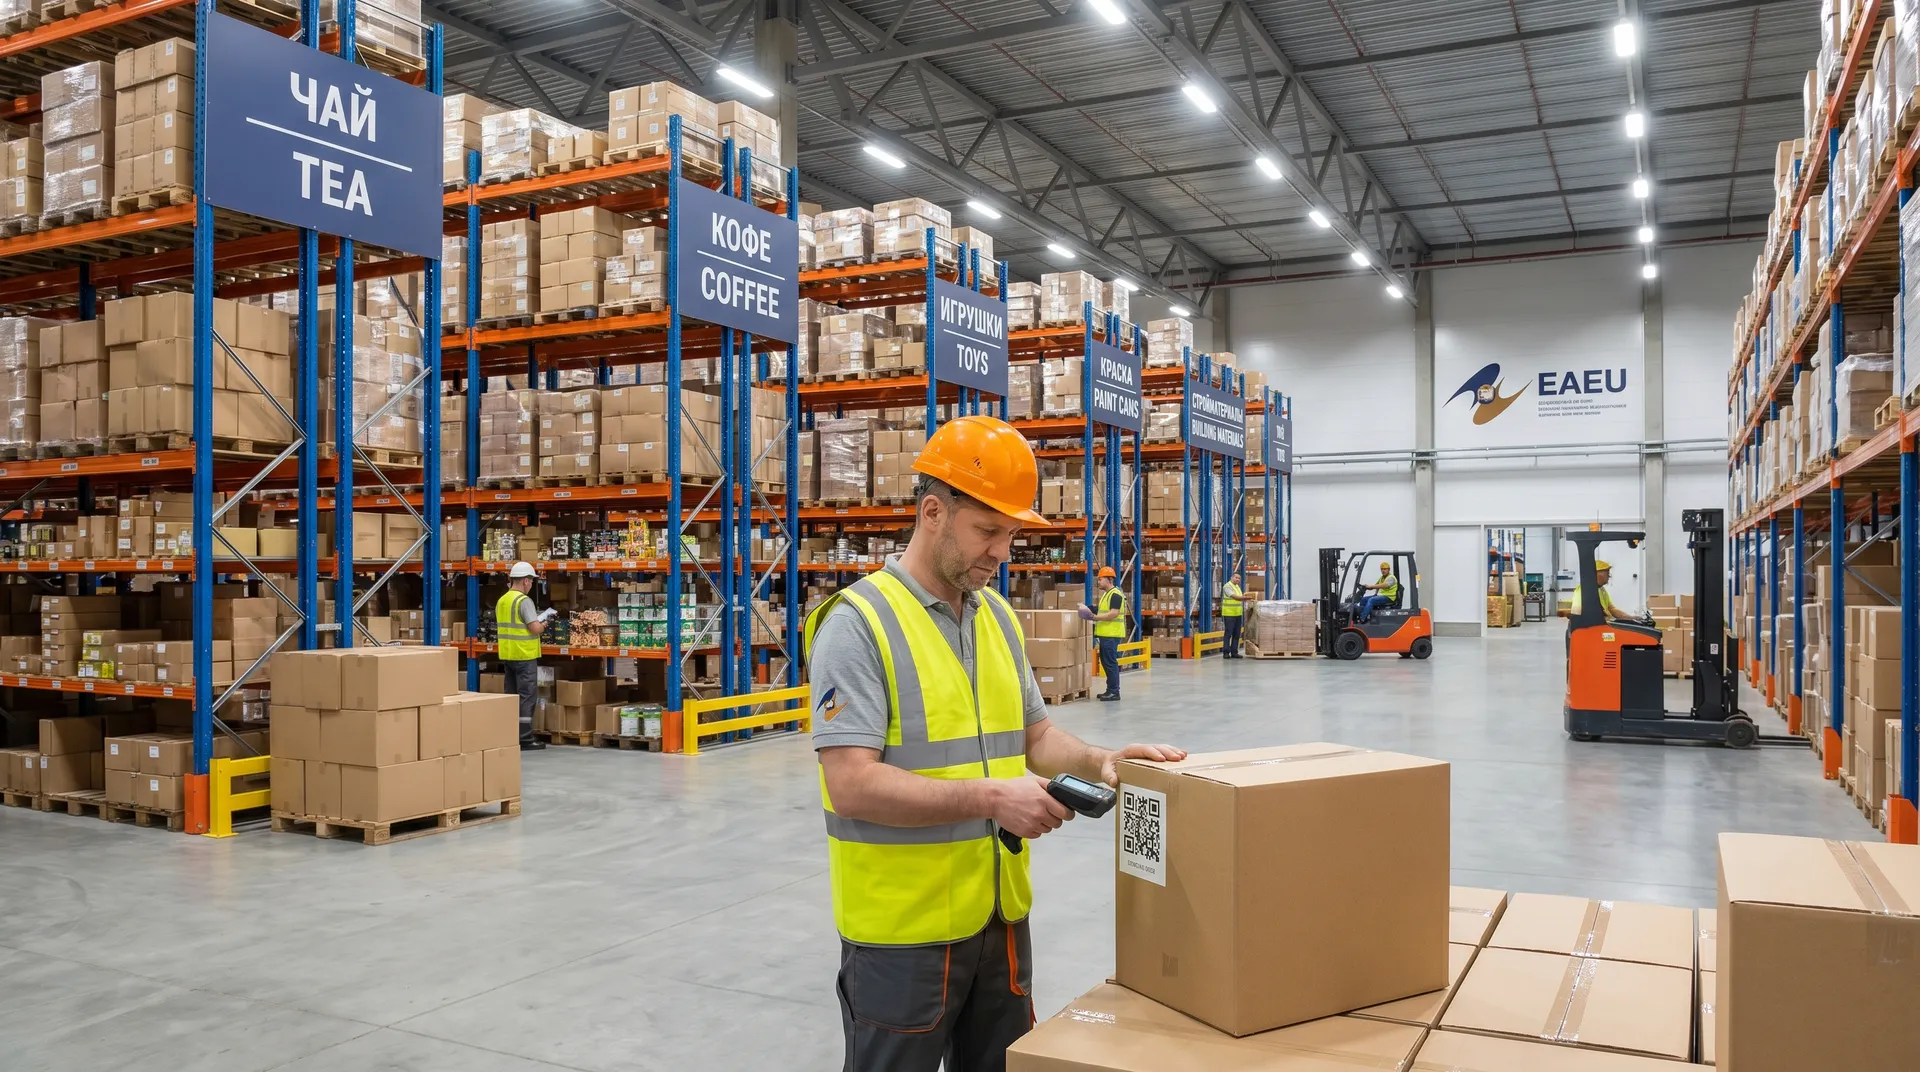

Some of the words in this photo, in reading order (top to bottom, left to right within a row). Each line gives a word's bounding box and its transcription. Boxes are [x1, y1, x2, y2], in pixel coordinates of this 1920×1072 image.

[291, 71, 377, 143] ЧАЙ
[292, 150, 373, 217] TEA
[711, 211, 772, 264] КОФЕ
[701, 266, 780, 320] COFFEE
[940, 295, 1003, 341] ИГРУШКИ
[957, 343, 989, 376] TOYS
[1100, 356, 1133, 386] КРАСКА
[1538, 368, 1627, 396] EAEU
[1094, 388, 1118, 413] PAINT
[1118, 395, 1140, 420] CANS
[1191, 419, 1217, 441] BUILDING
